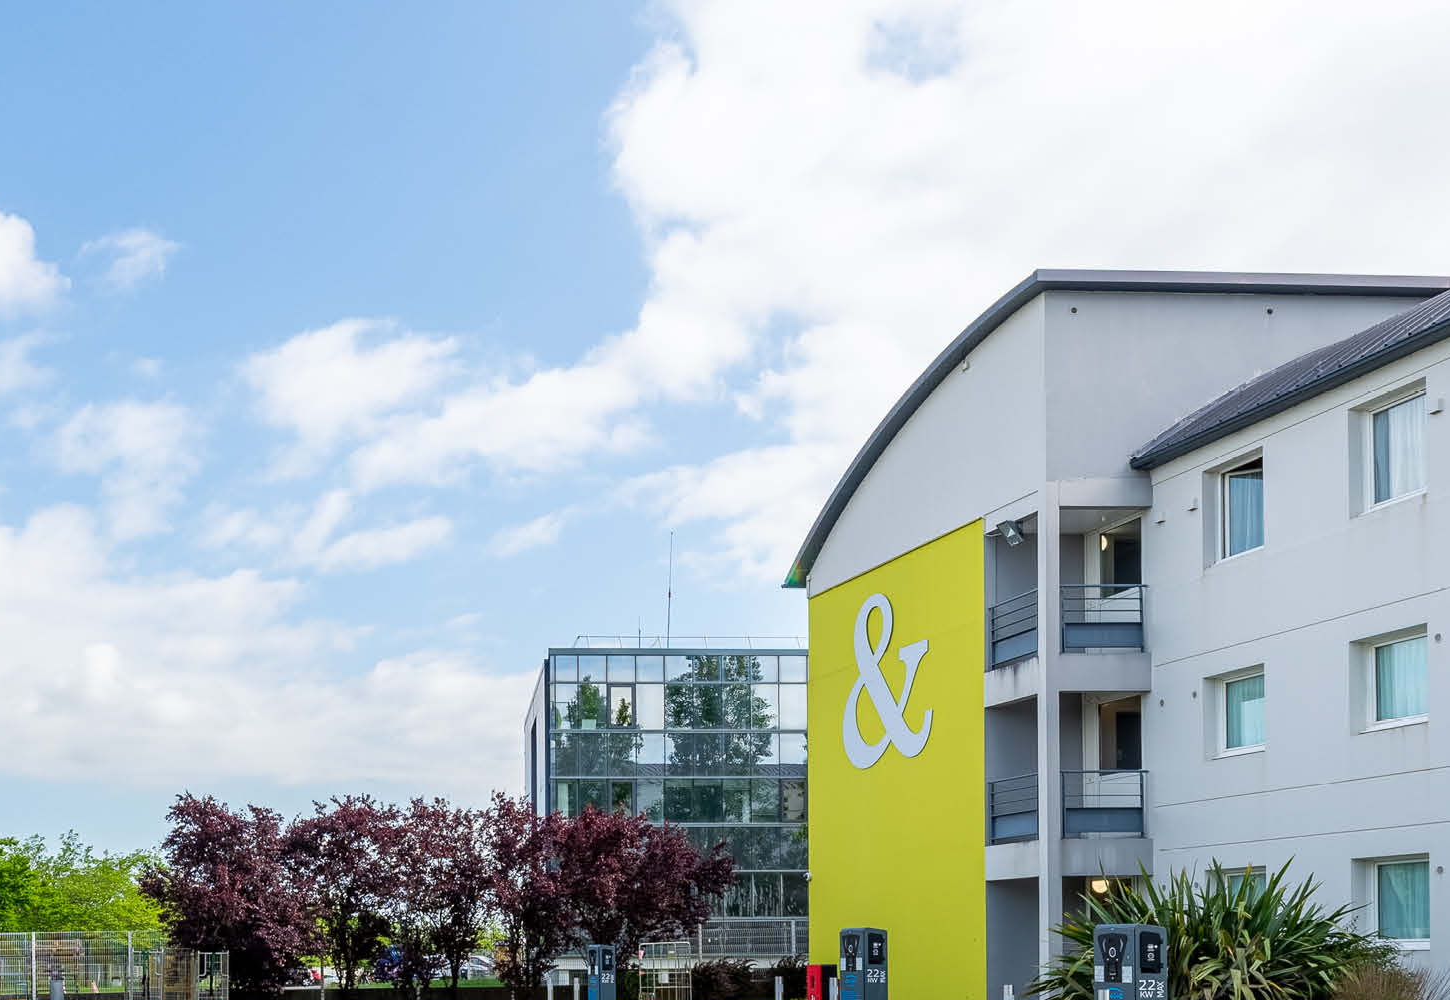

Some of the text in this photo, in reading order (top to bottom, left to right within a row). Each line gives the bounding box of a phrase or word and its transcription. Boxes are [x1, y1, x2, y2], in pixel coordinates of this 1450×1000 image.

[842, 592, 934, 769] &
[866, 968, 880, 978] 22
[1139, 979, 1156, 990] 22
[1156, 981, 1165, 998] MAX
[1139, 990, 1154, 998] KW
